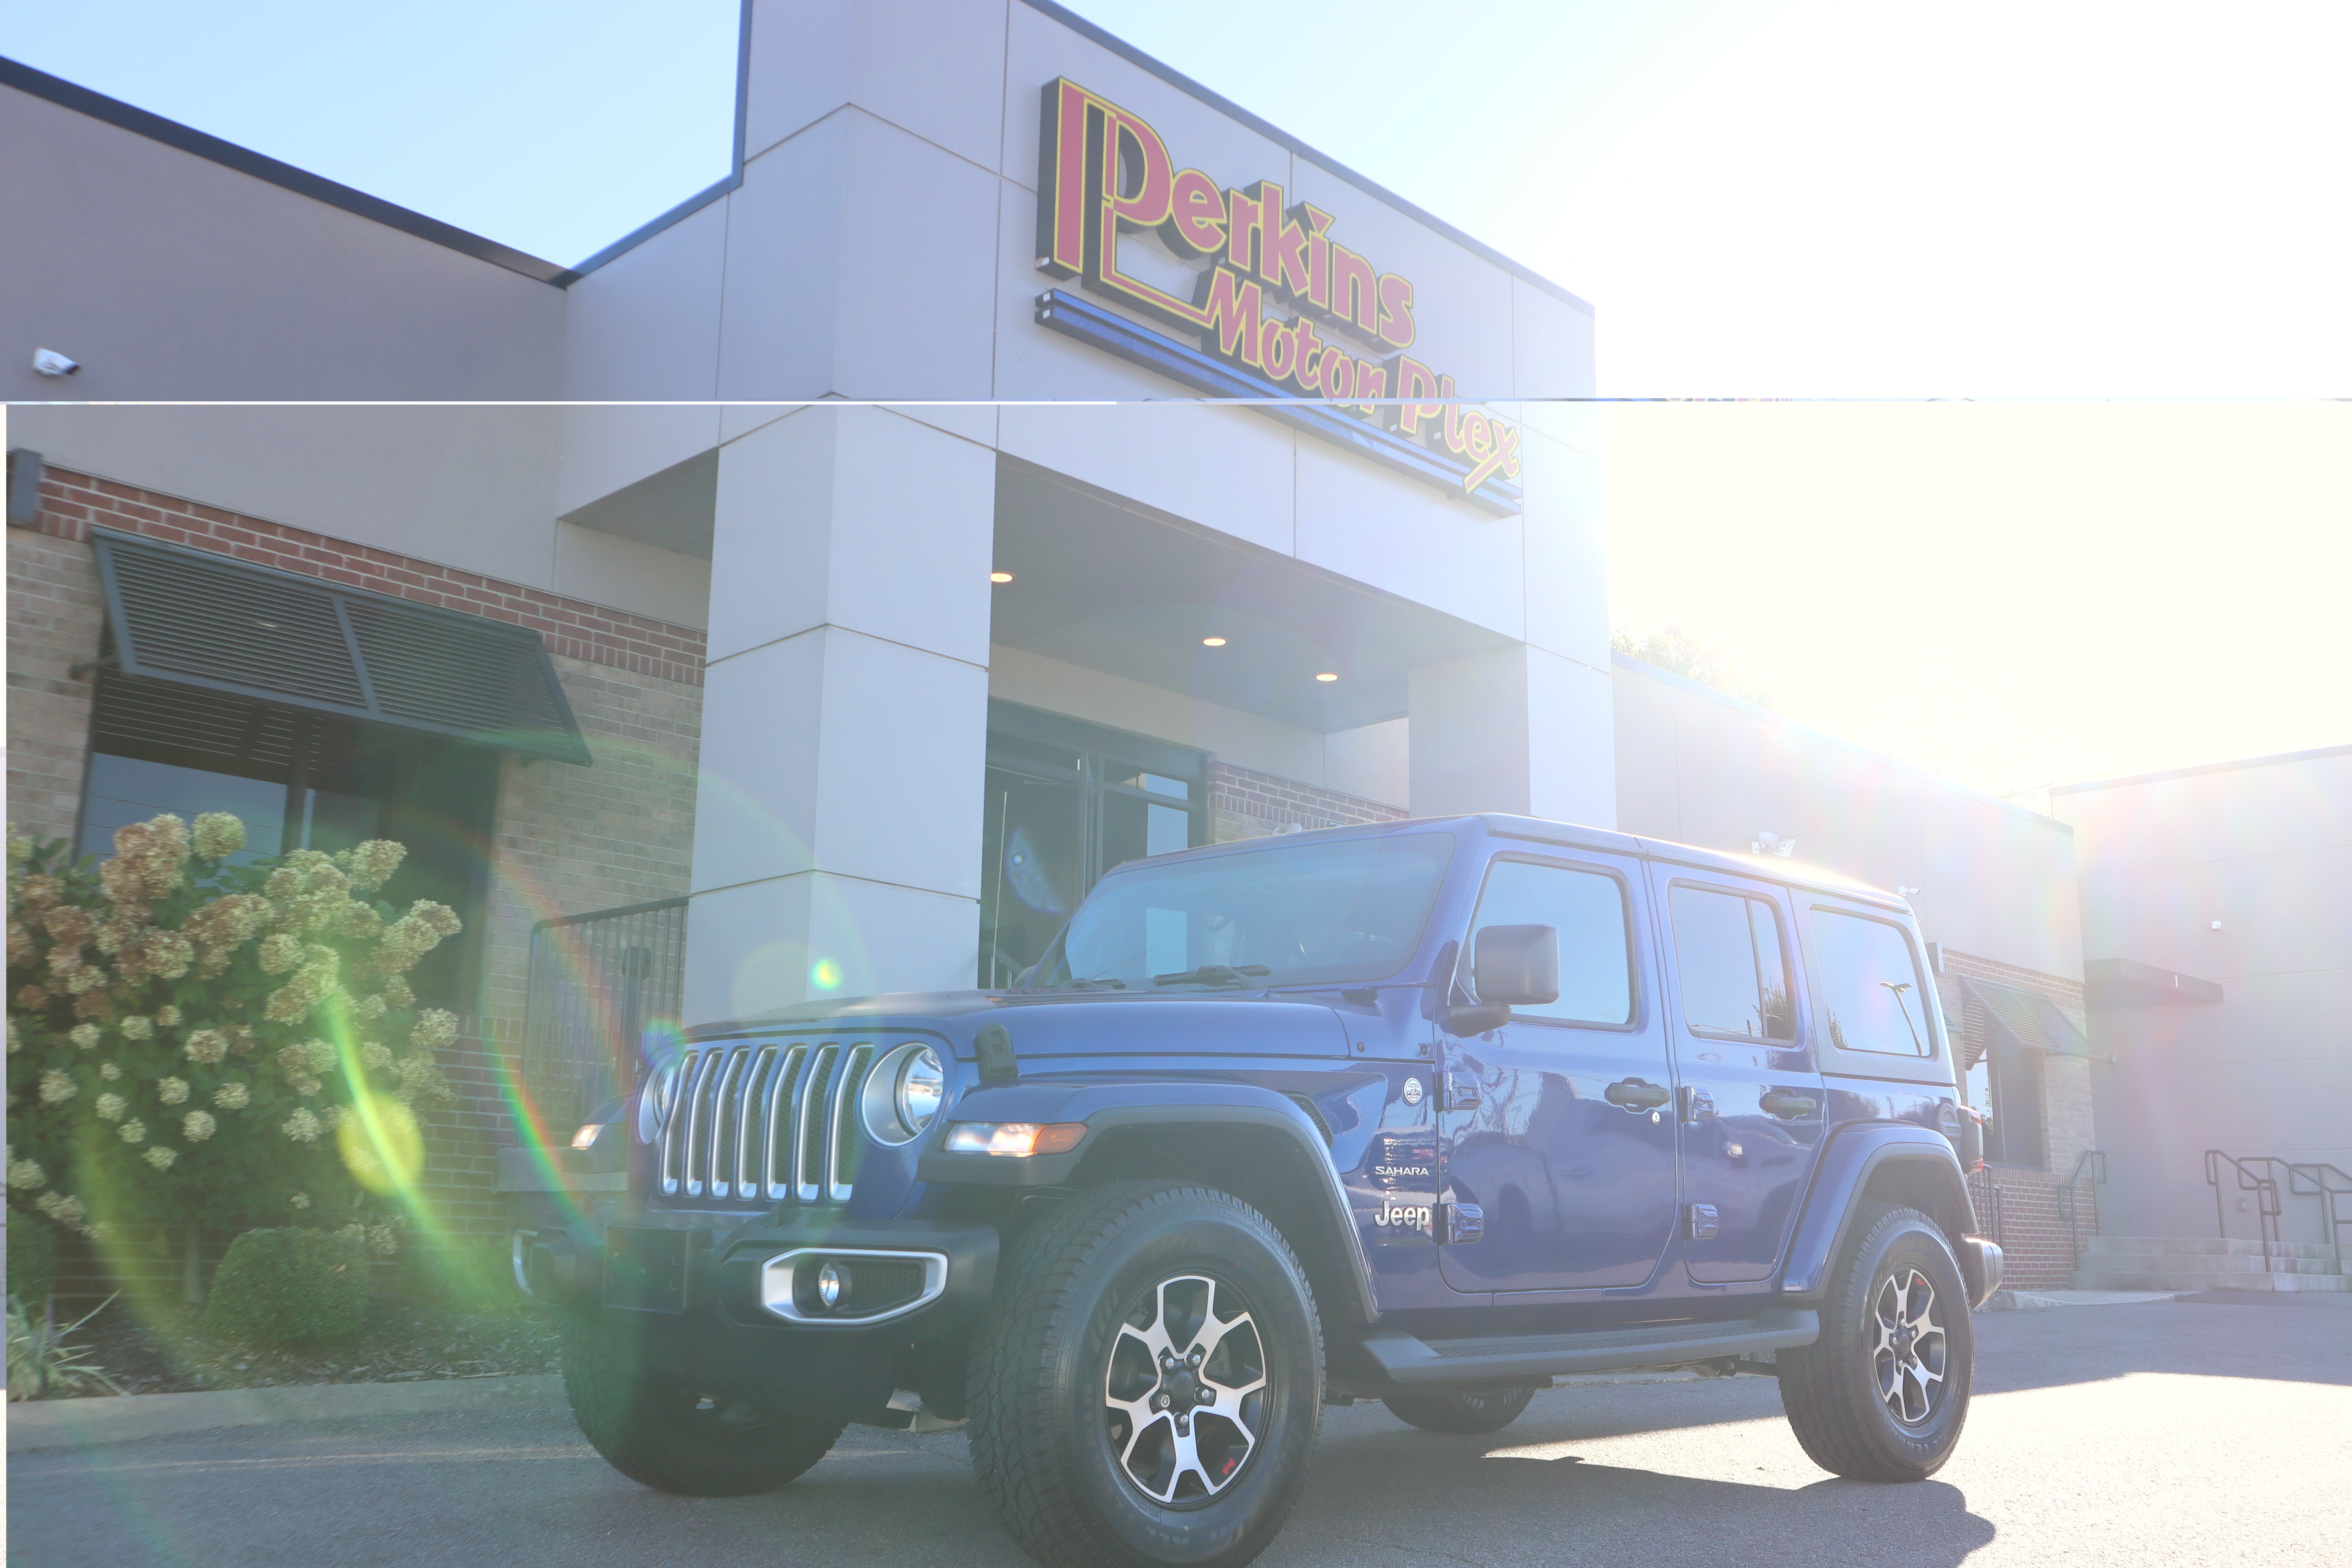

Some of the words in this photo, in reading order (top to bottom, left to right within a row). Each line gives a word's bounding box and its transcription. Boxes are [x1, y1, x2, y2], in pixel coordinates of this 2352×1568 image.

[1053, 76, 1416, 350] Perkins
[1207, 266, 1388, 416] Motor
[1398, 354, 1521, 494] Plex
[1374, 1166, 1429, 1176] SAHARA
[1374, 1200, 1430, 1231] Jeep
[1146, 1526, 1191, 1553] ALL
